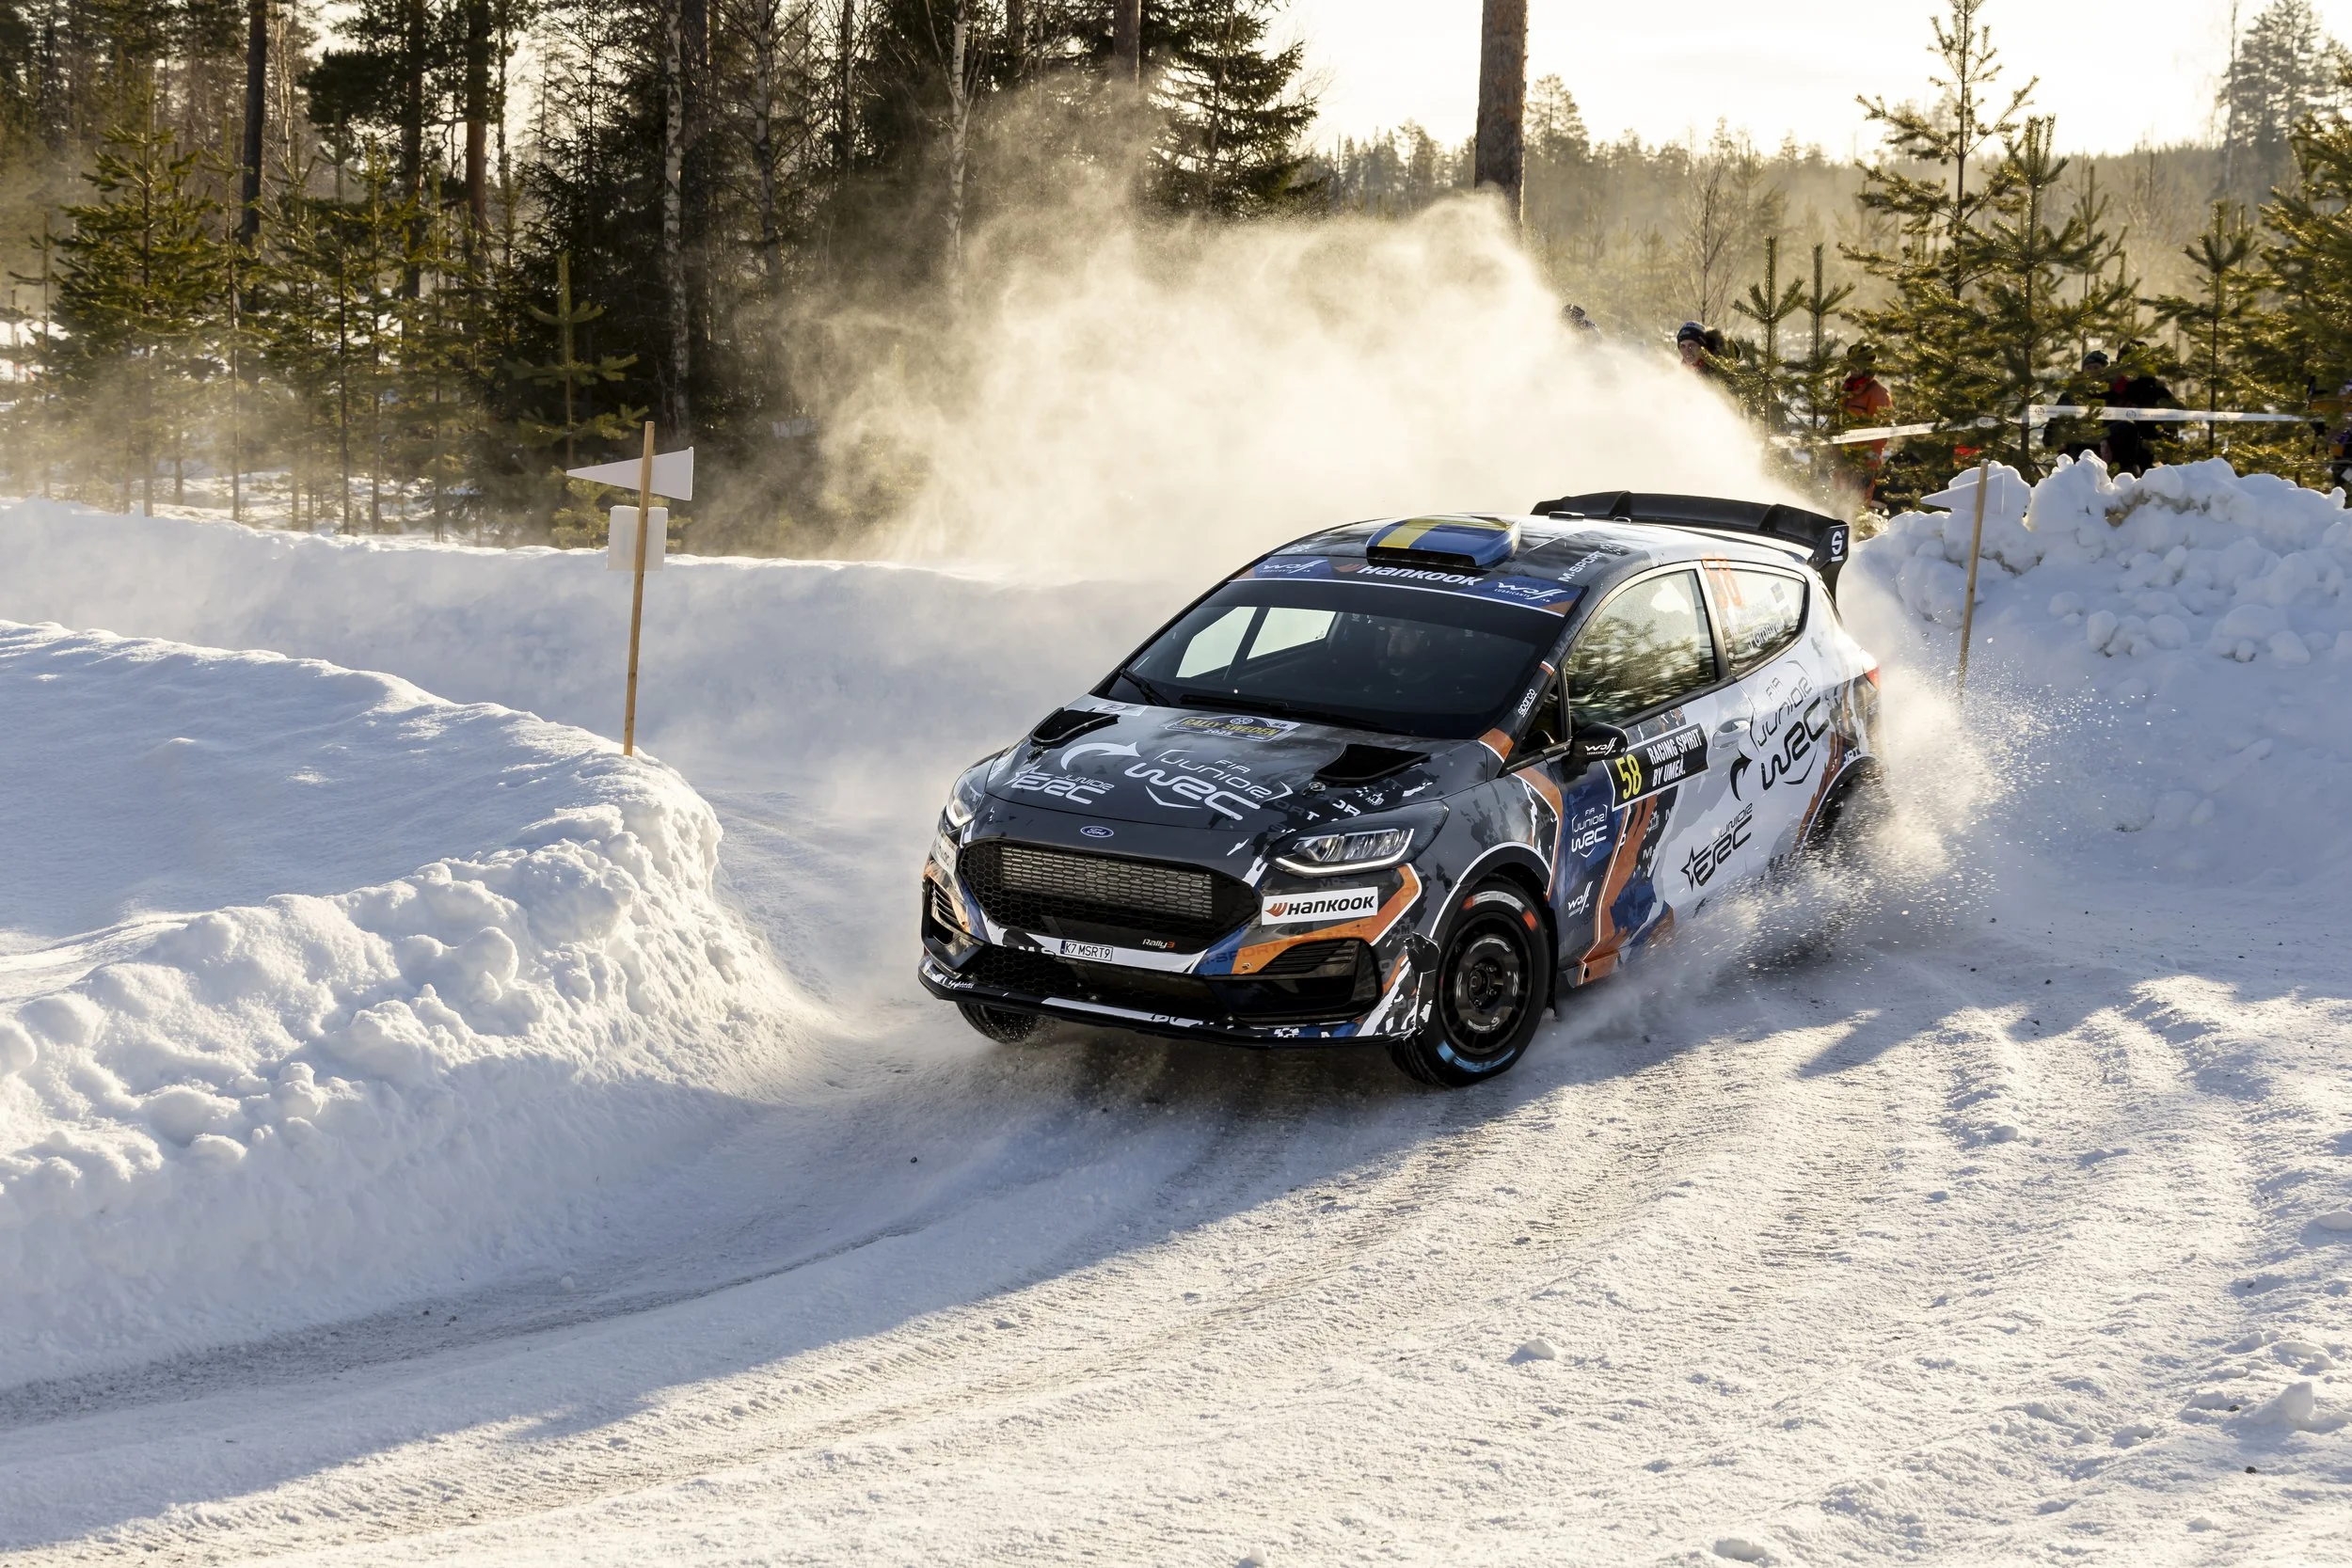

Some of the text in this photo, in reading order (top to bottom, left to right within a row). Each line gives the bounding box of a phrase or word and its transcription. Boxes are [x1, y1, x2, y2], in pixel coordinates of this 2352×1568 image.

[1765, 676, 1783, 703] FIA
[1518, 689, 1536, 718] sparco
[1756, 676, 1813, 747] JUNIOR
[1182, 718, 1280, 736] RALLY SWEDEN
[1646, 738, 1679, 765] RACING
[1676, 728, 1703, 753] SPIRIT
[1760, 697, 1830, 791] WRC
[1161, 757, 1273, 799] JUNIOR
[1214, 759, 1251, 773] FIA
[1614, 753, 1643, 800] 58
[1652, 767, 1664, 787] BY
[1055, 775, 1115, 791] JUNIOR
[1123, 763, 1262, 820] WRC
[1573, 814, 1605, 832] JUNIOR
[1584, 807, 1596, 817] FIA
[1711, 802, 1753, 845] JUNIOR
[1571, 825, 1608, 853] WRC
[1065, 942, 1076, 954] K7
[1077, 944, 1111, 959] MSRT9
[1142, 939, 1176, 949] Rally3
